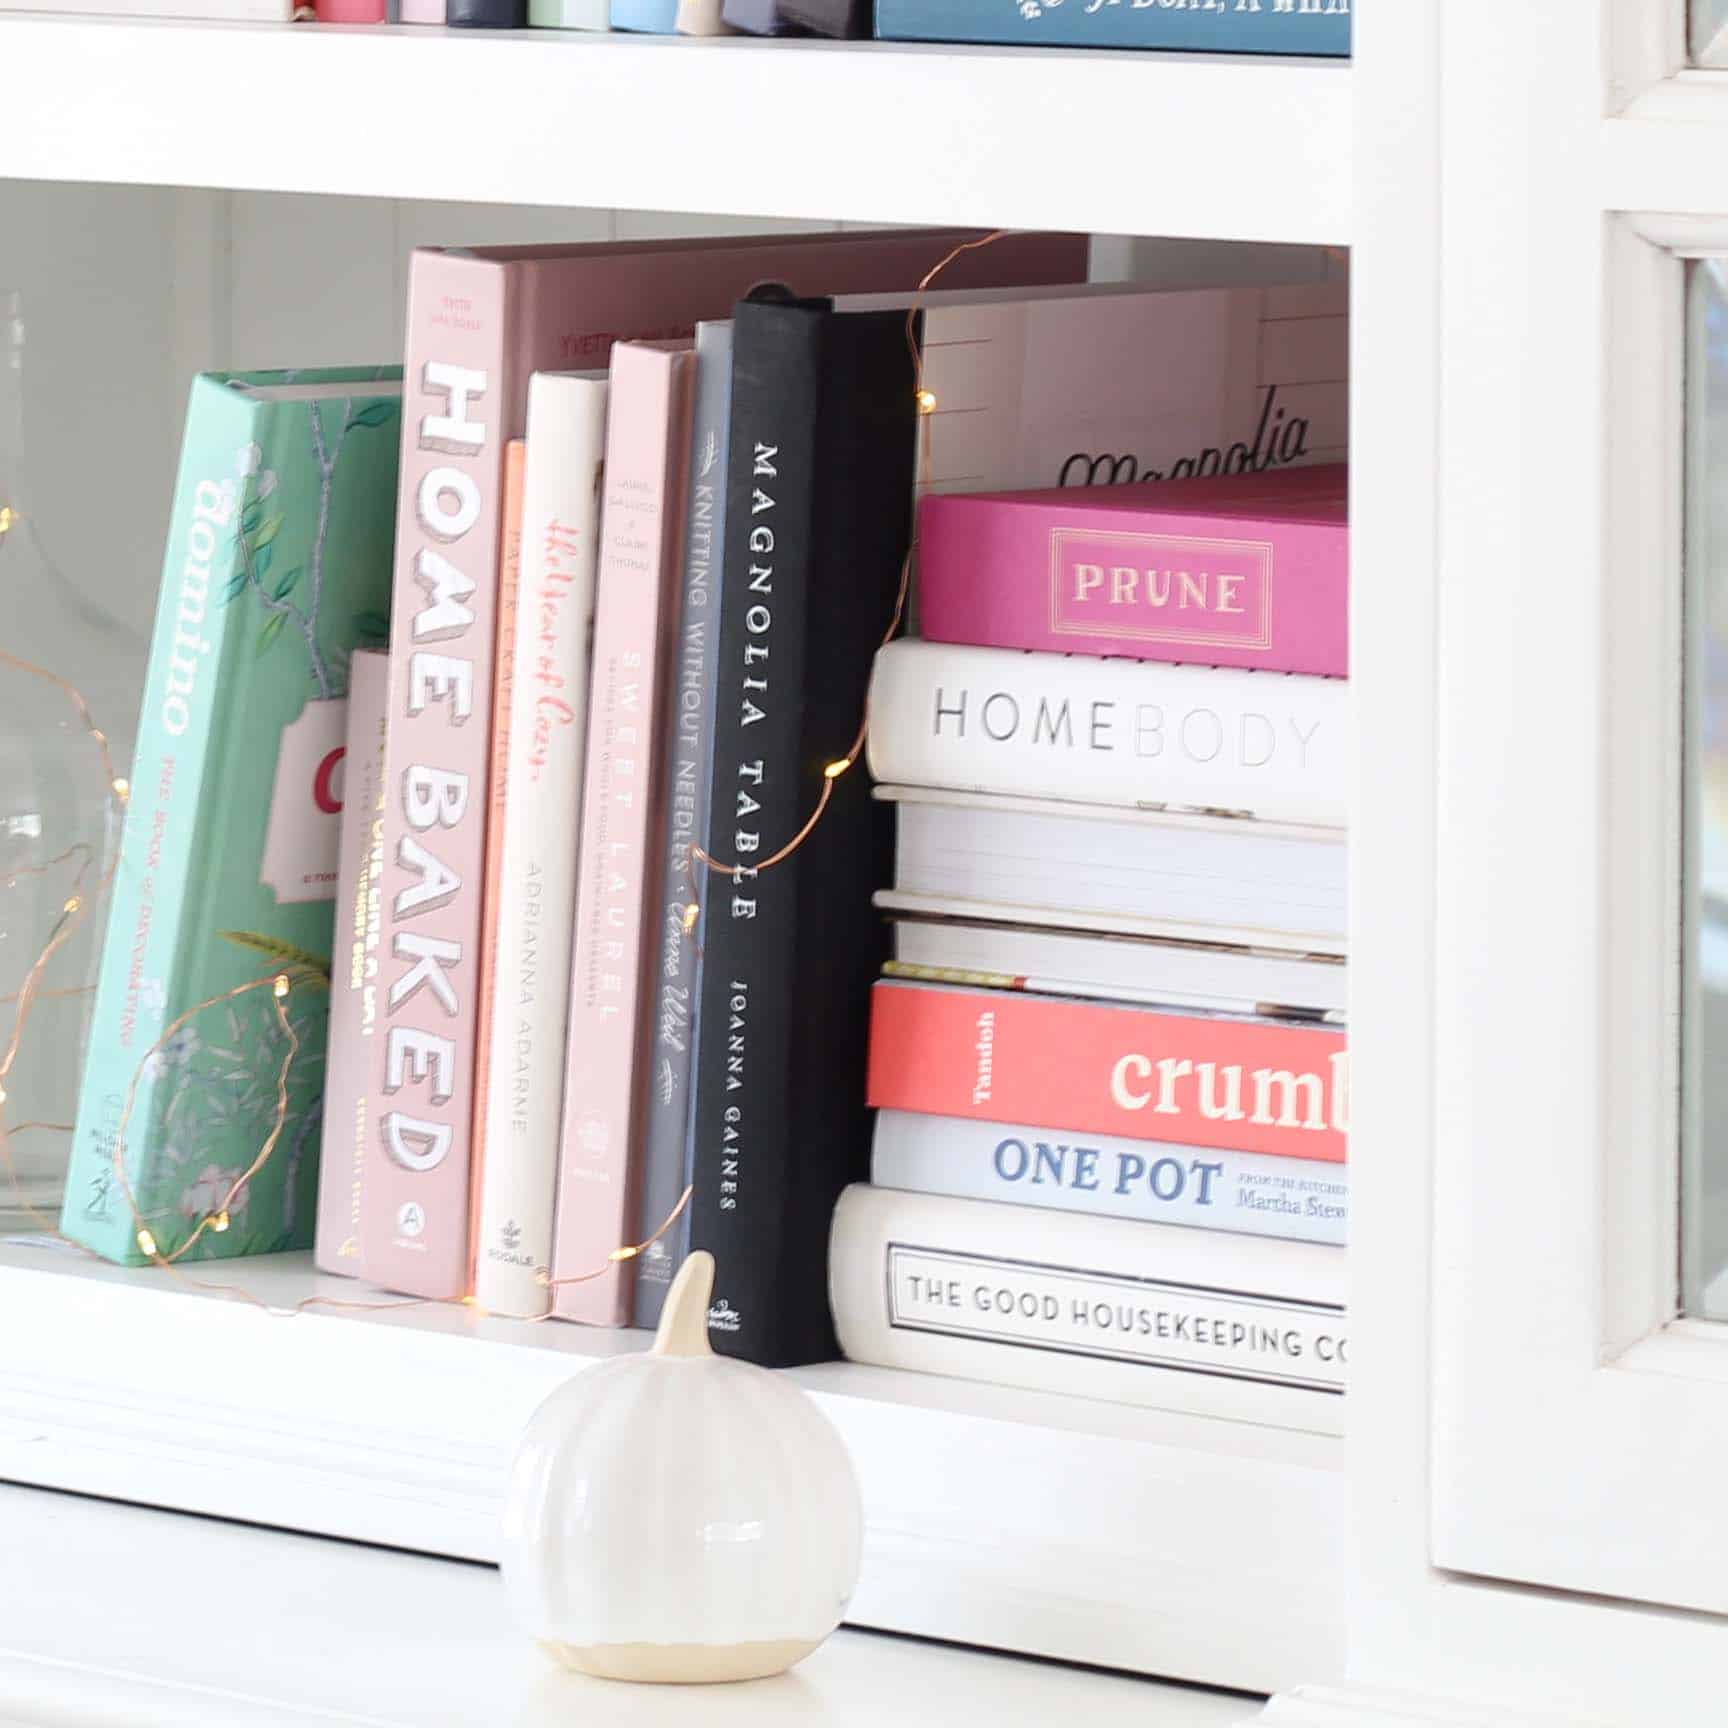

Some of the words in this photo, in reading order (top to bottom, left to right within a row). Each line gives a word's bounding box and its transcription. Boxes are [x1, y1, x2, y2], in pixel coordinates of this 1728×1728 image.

[407, 360, 490, 728] HOME
[545, 518, 581, 568] the
[688, 485, 713, 607] KNITTING
[740, 442, 779, 728] MAGNOLIA
[1072, 562, 1246, 614] PRUNE
[160, 479, 236, 736] domino
[535, 569, 576, 650] Year
[535, 655, 565, 688] of
[679, 621, 705, 749] WITHOUT
[157, 752, 176, 801] THE
[614, 651, 644, 808] SWEET
[933, 686, 1322, 770] HOMEBODY
[671, 758, 696, 872] NEEDLES
[731, 760, 765, 921] TABLE
[382, 764, 472, 1173] BAKED
[517, 860, 544, 1005] ADRIANNA
[599, 841, 631, 1025] LAUREL
[664, 902, 692, 977] Anne
[660, 987, 690, 1052] Weil
[725, 980, 748, 1092] JOANNA
[971, 1010, 996, 1106] Tandoh
[510, 1018, 534, 1139] ADARME
[719, 1107, 741, 1211] GAINES
[994, 1138, 1100, 1192] ONE
[1114, 1152, 1224, 1206] POT
[1236, 1188, 1301, 1215] Martha
[907, 1275, 962, 1308] THE
[974, 1286, 1059, 1320] GOOD
[1071, 1298, 1303, 1357] HOUSEKEEPING
